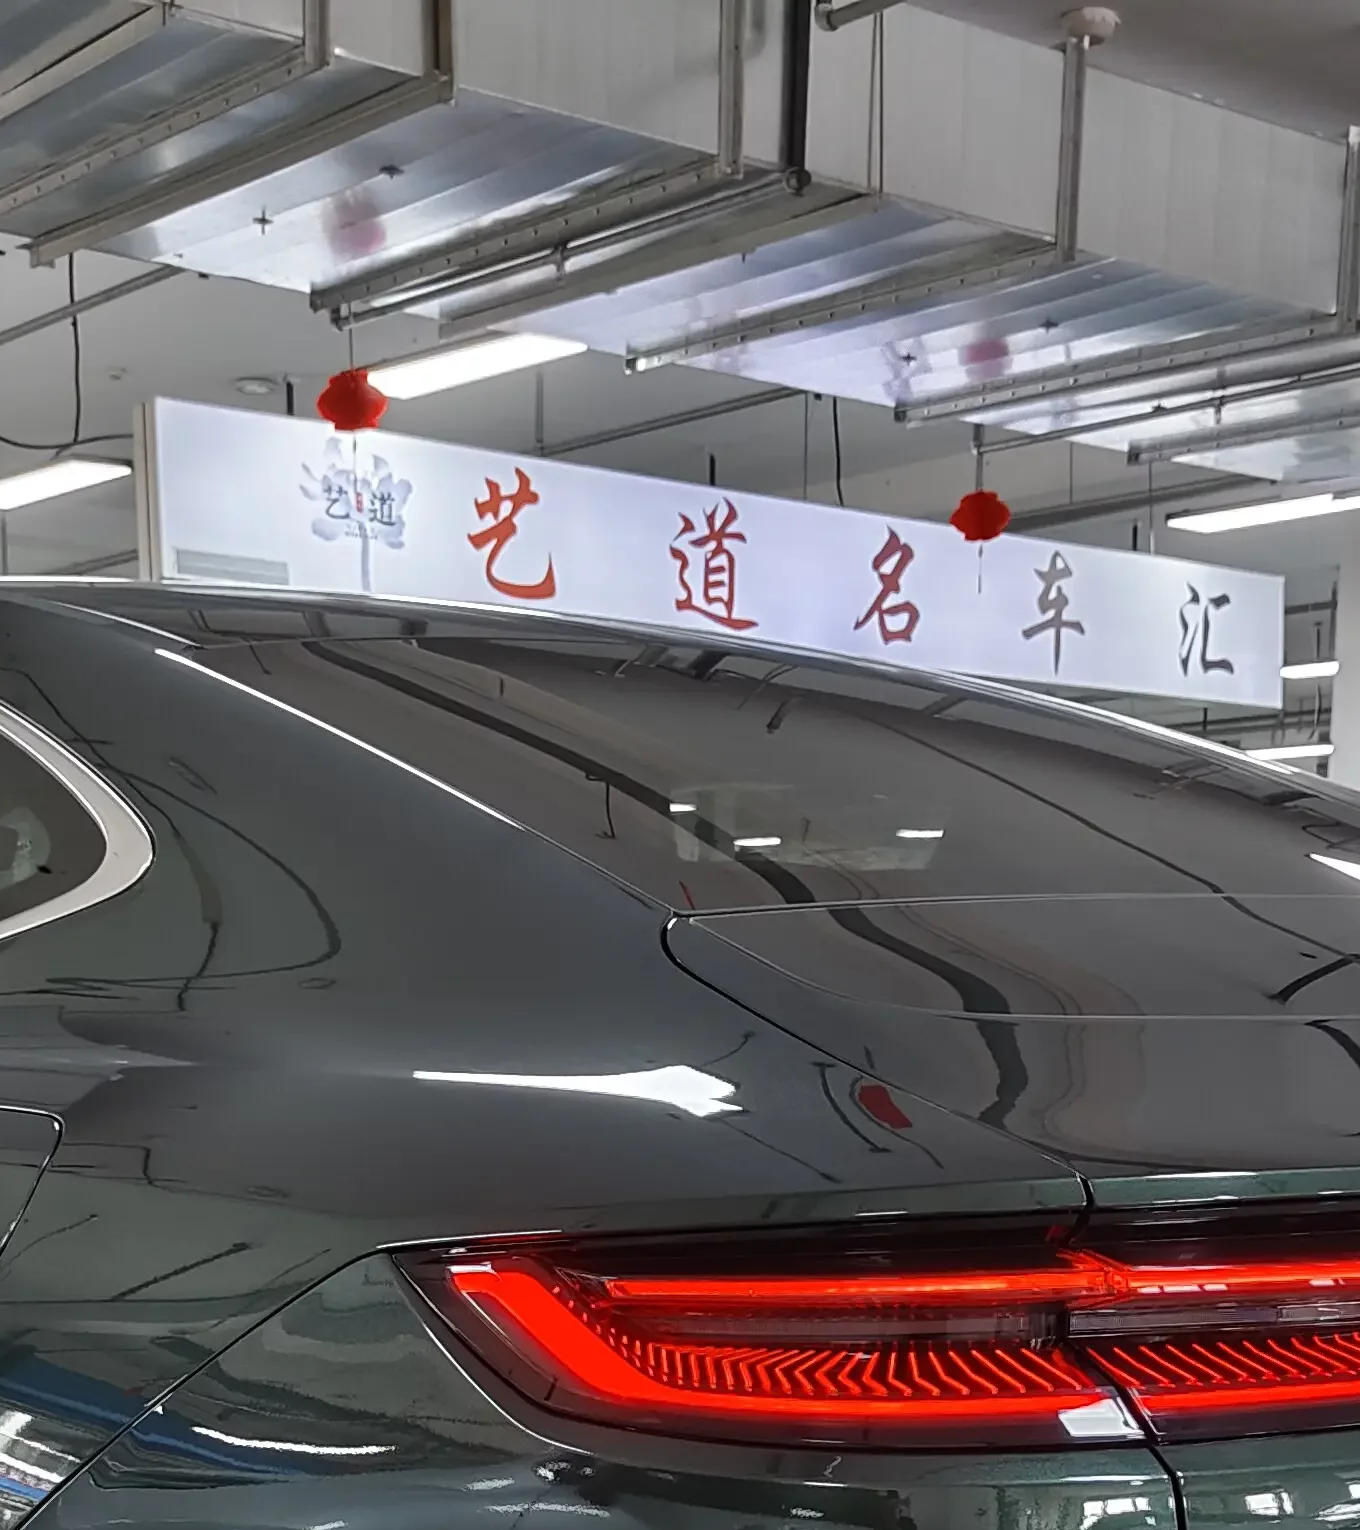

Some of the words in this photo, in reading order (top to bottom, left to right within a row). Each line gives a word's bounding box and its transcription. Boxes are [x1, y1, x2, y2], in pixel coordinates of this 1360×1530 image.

[466, 466, 1235, 677] 艺道名车汇
